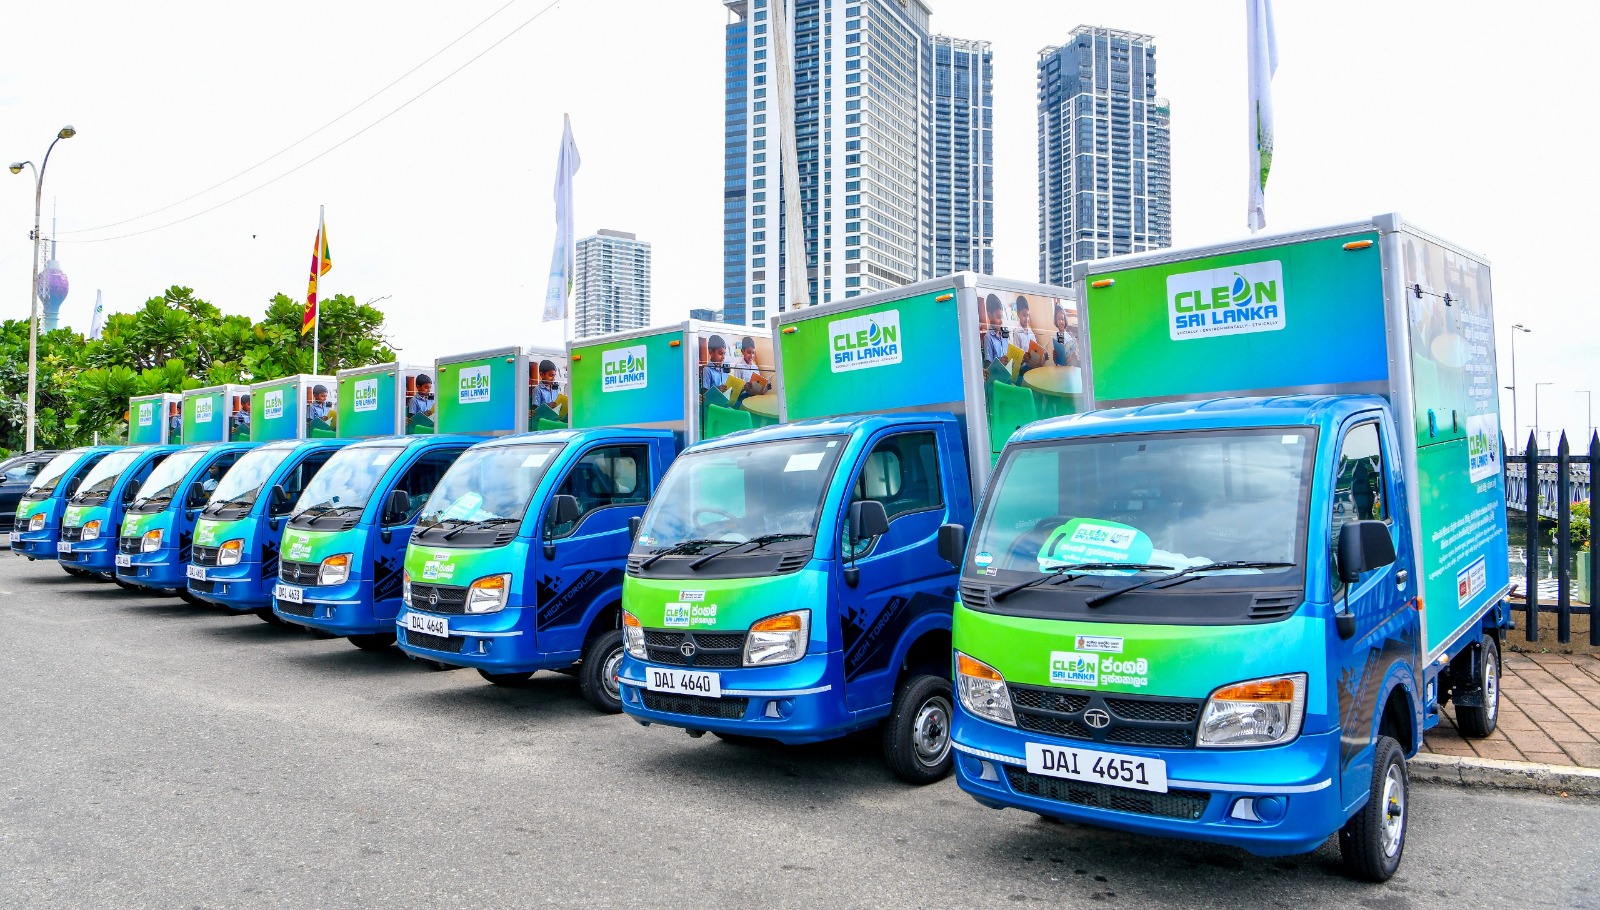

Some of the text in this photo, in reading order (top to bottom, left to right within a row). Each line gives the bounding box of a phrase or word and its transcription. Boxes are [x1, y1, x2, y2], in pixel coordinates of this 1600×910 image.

[1176, 305, 1278, 329] SRI LANKA
[835, 351, 854, 363] SRI
[857, 344, 898, 360] LANKA
[605, 372, 645, 385] SRI LANKA
[543, 573, 593, 620] HIGH TORQUE
[412, 615, 444, 634] DAI 4648
[850, 600, 899, 666] HIGH TORQUE
[653, 671, 711, 692] DAI 4640
[1068, 671, 1095, 681] LANKA
[1041, 748, 1149, 785] DAI 4651
